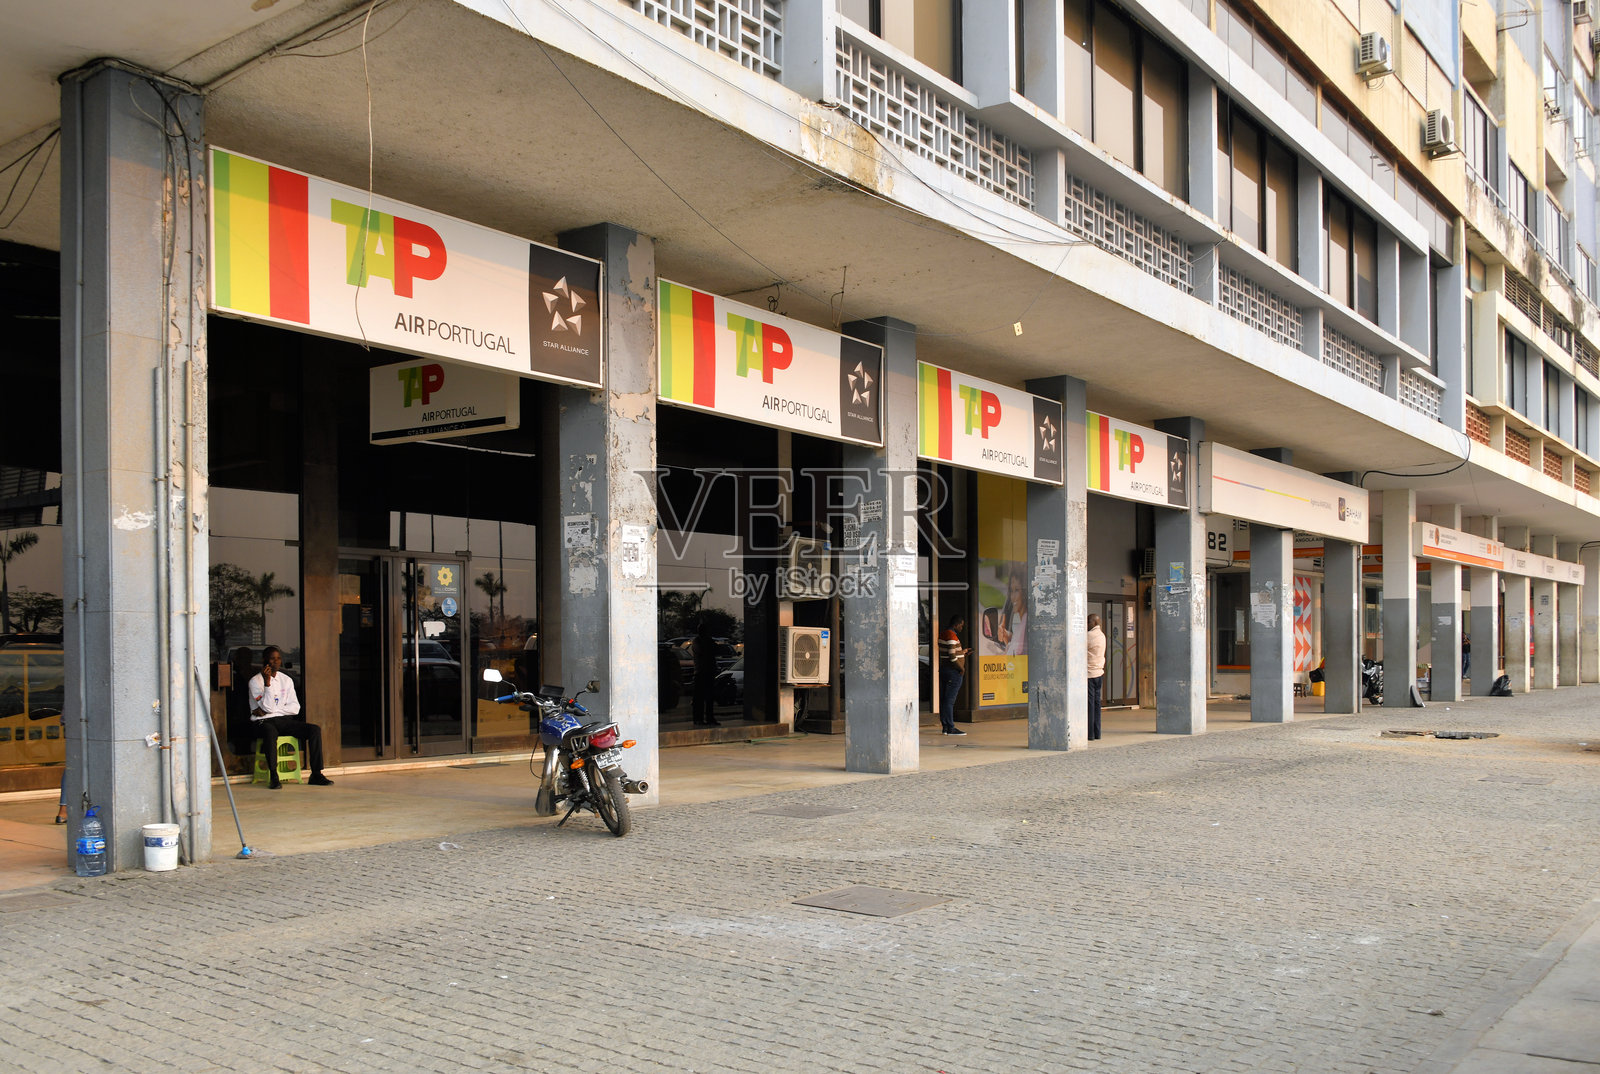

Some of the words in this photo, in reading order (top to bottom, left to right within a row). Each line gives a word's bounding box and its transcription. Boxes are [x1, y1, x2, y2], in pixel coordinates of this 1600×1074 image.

[331, 198, 447, 299] TAP
[542, 340, 559, 349] STAR
[560, 344, 589, 356] ALLIANCE
[727, 311, 793, 385] TAP
[398, 363, 445, 408] TAP
[959, 383, 1002, 440] TAP
[1114, 428, 1145, 474] TAP
[1208, 531, 1227, 552] 82
